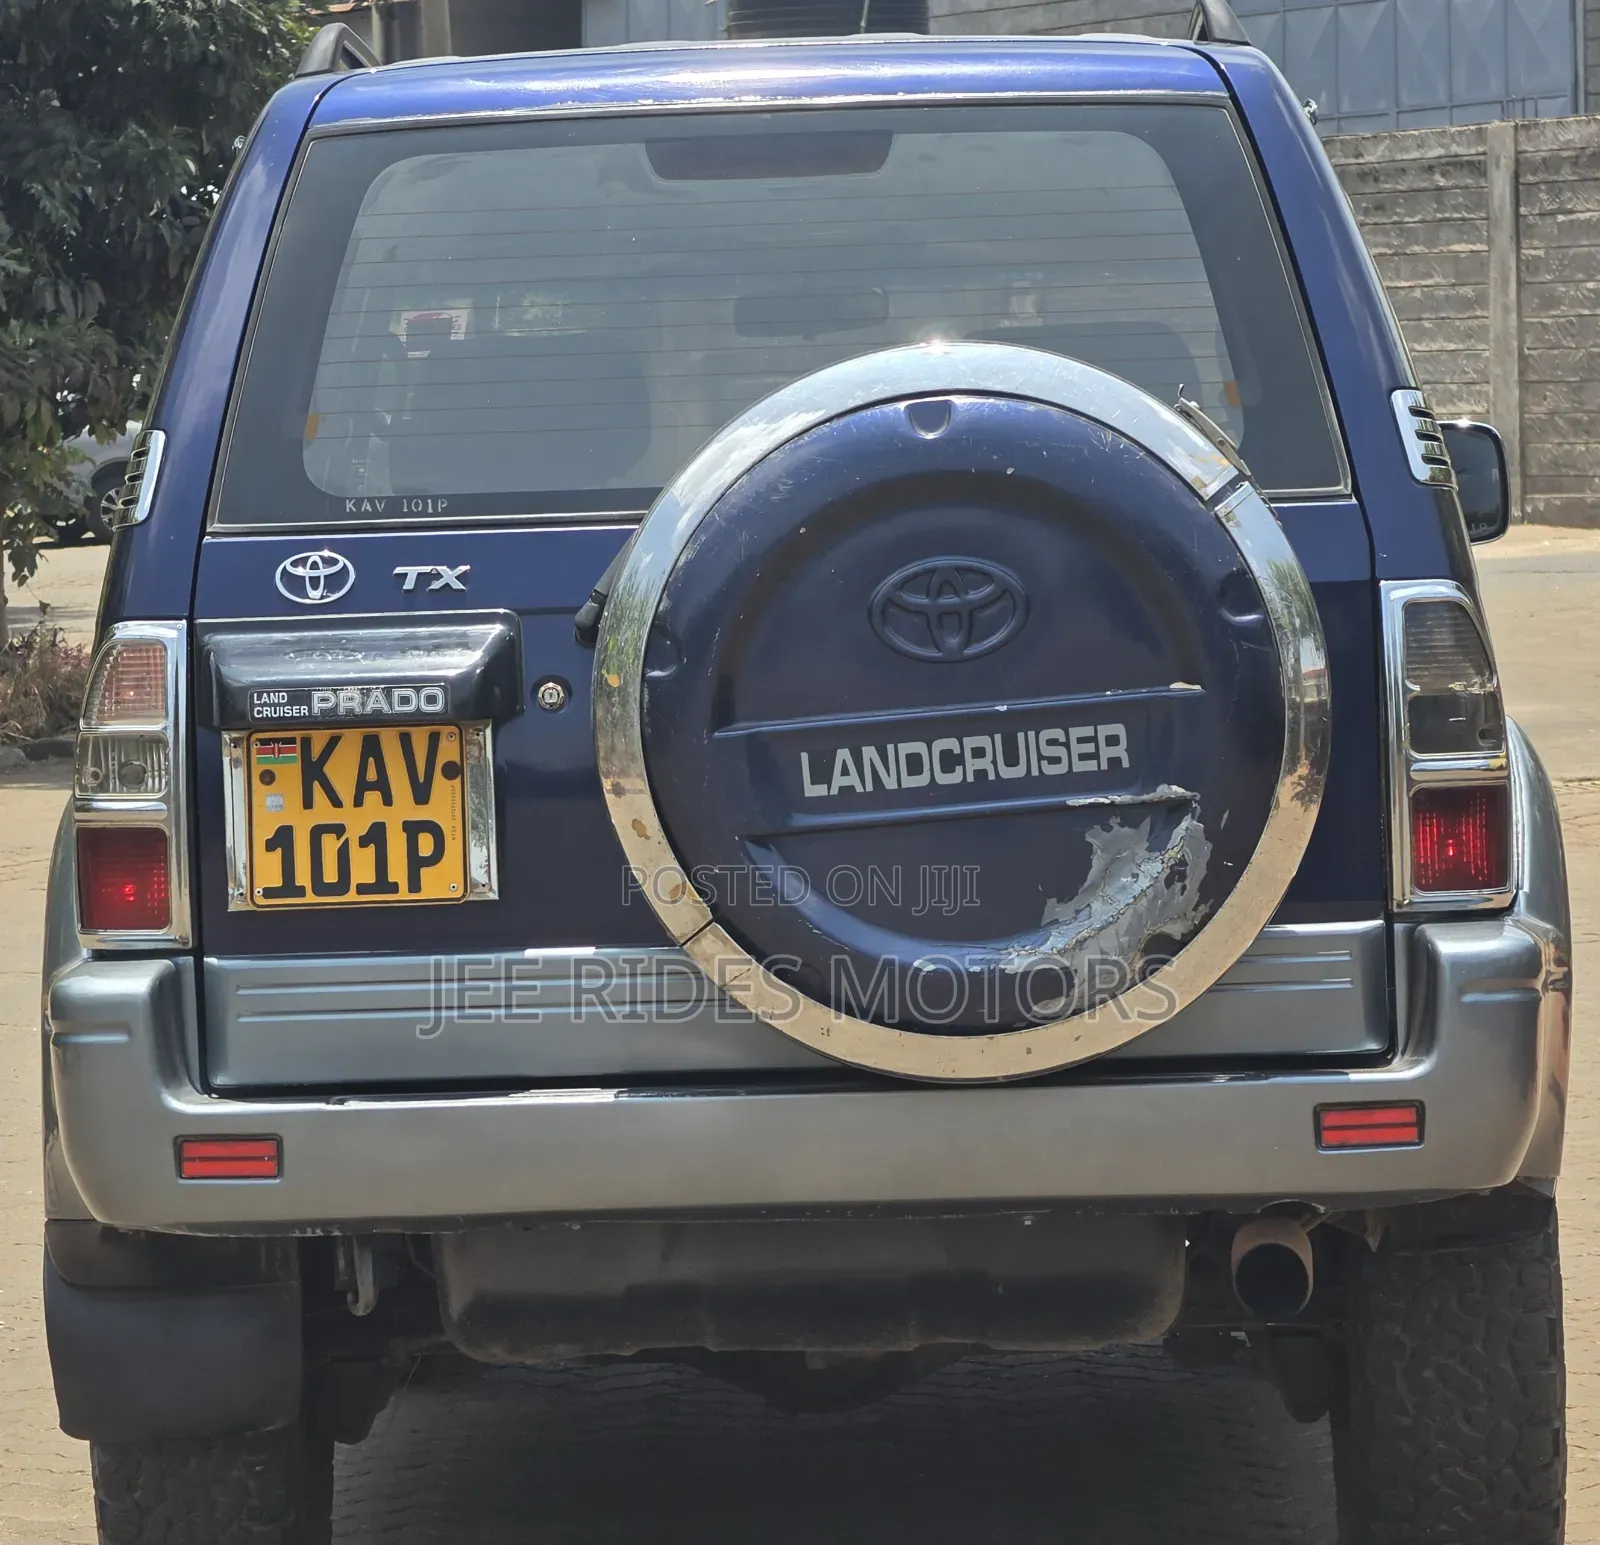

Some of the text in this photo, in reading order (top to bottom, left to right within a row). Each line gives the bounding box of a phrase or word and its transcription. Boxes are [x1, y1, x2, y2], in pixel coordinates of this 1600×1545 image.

[345, 498, 448, 513] KAV 101P
[393, 564, 471, 591] TX
[253, 692, 288, 704] LAND
[253, 705, 309, 718] CRUISER
[311, 686, 445, 716] PRADO
[301, 731, 441, 810] KAV
[799, 722, 1131, 798] LANDCRUISER
[262, 820, 446, 899] 101P
